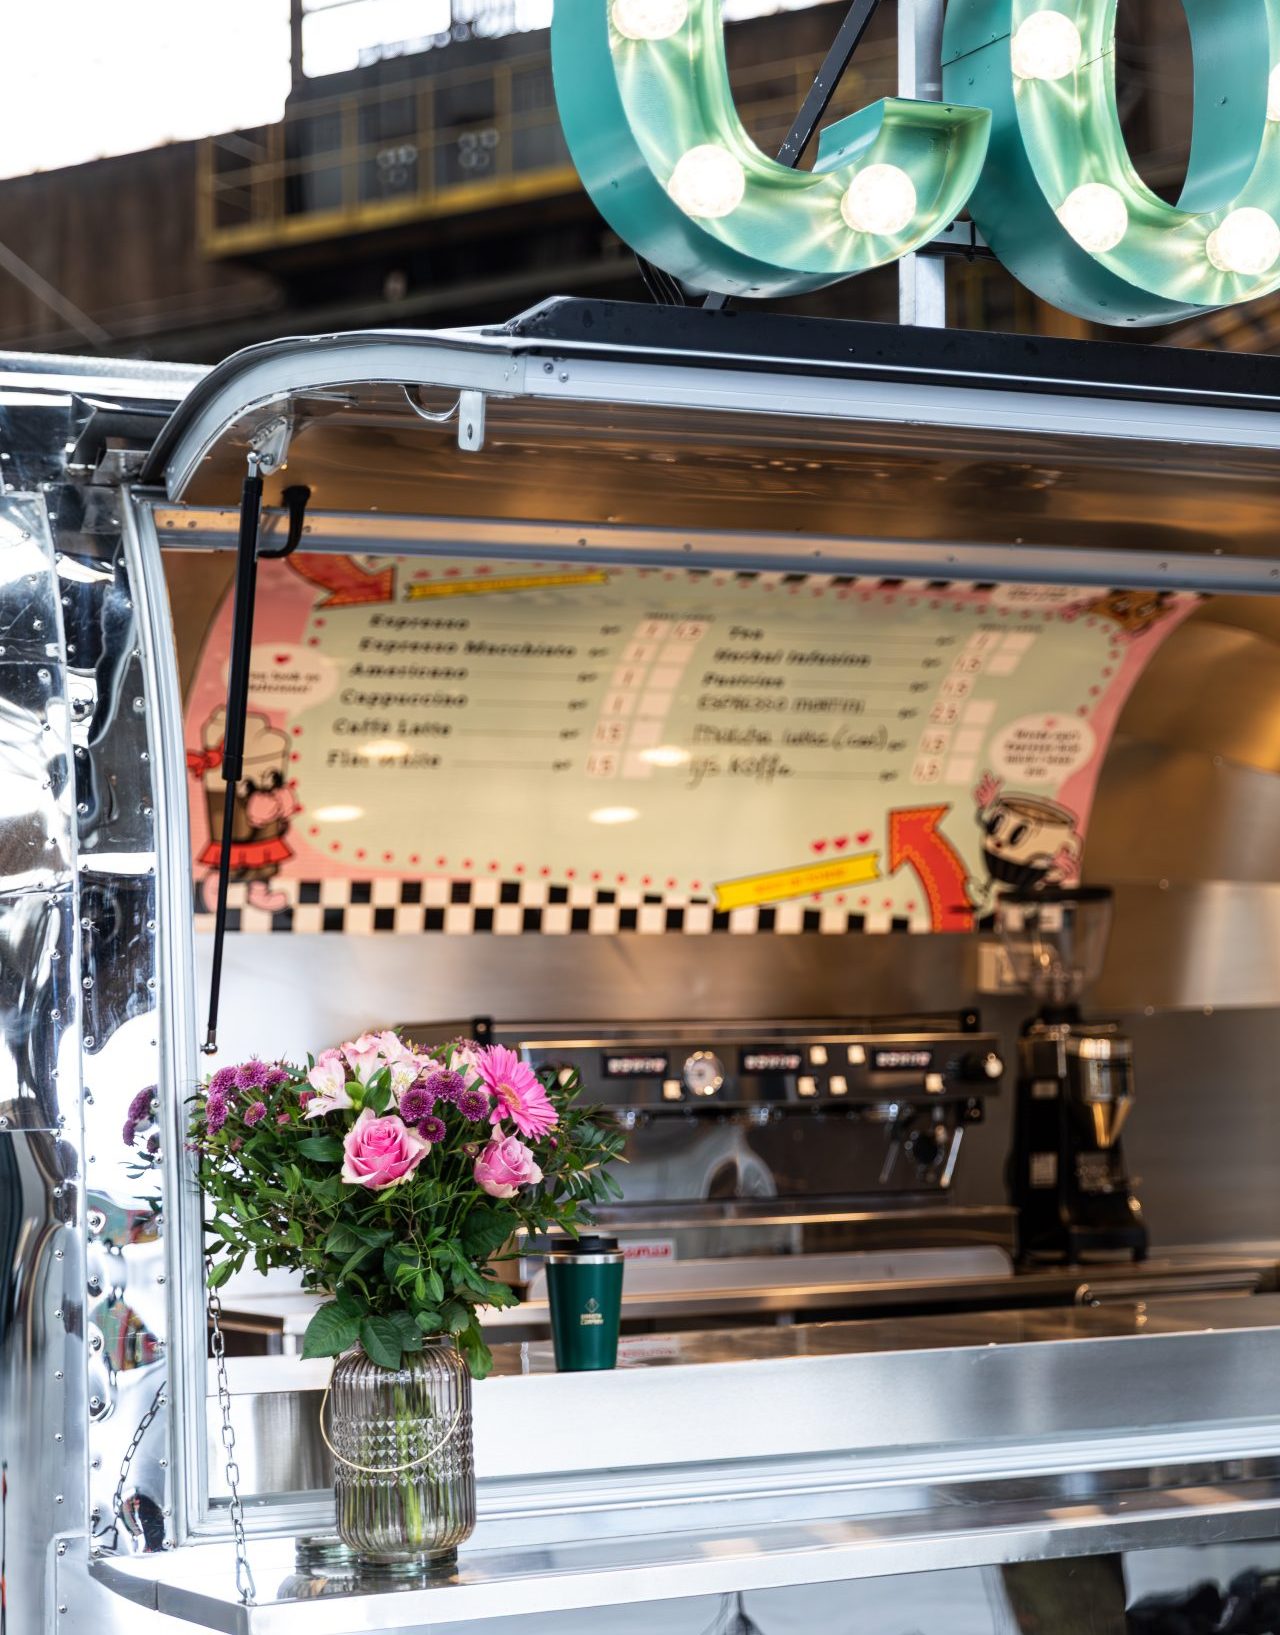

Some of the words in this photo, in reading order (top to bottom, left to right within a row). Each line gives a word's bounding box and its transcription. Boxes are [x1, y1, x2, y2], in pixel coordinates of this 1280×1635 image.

[370, 613, 470, 631] Espresso
[359, 636, 459, 655] Espresso
[464, 640, 577, 657] Macchiato
[350, 661, 469, 681] Americano
[340, 688, 469, 710] Cappuccino
[397, 719, 453, 738] Latte
